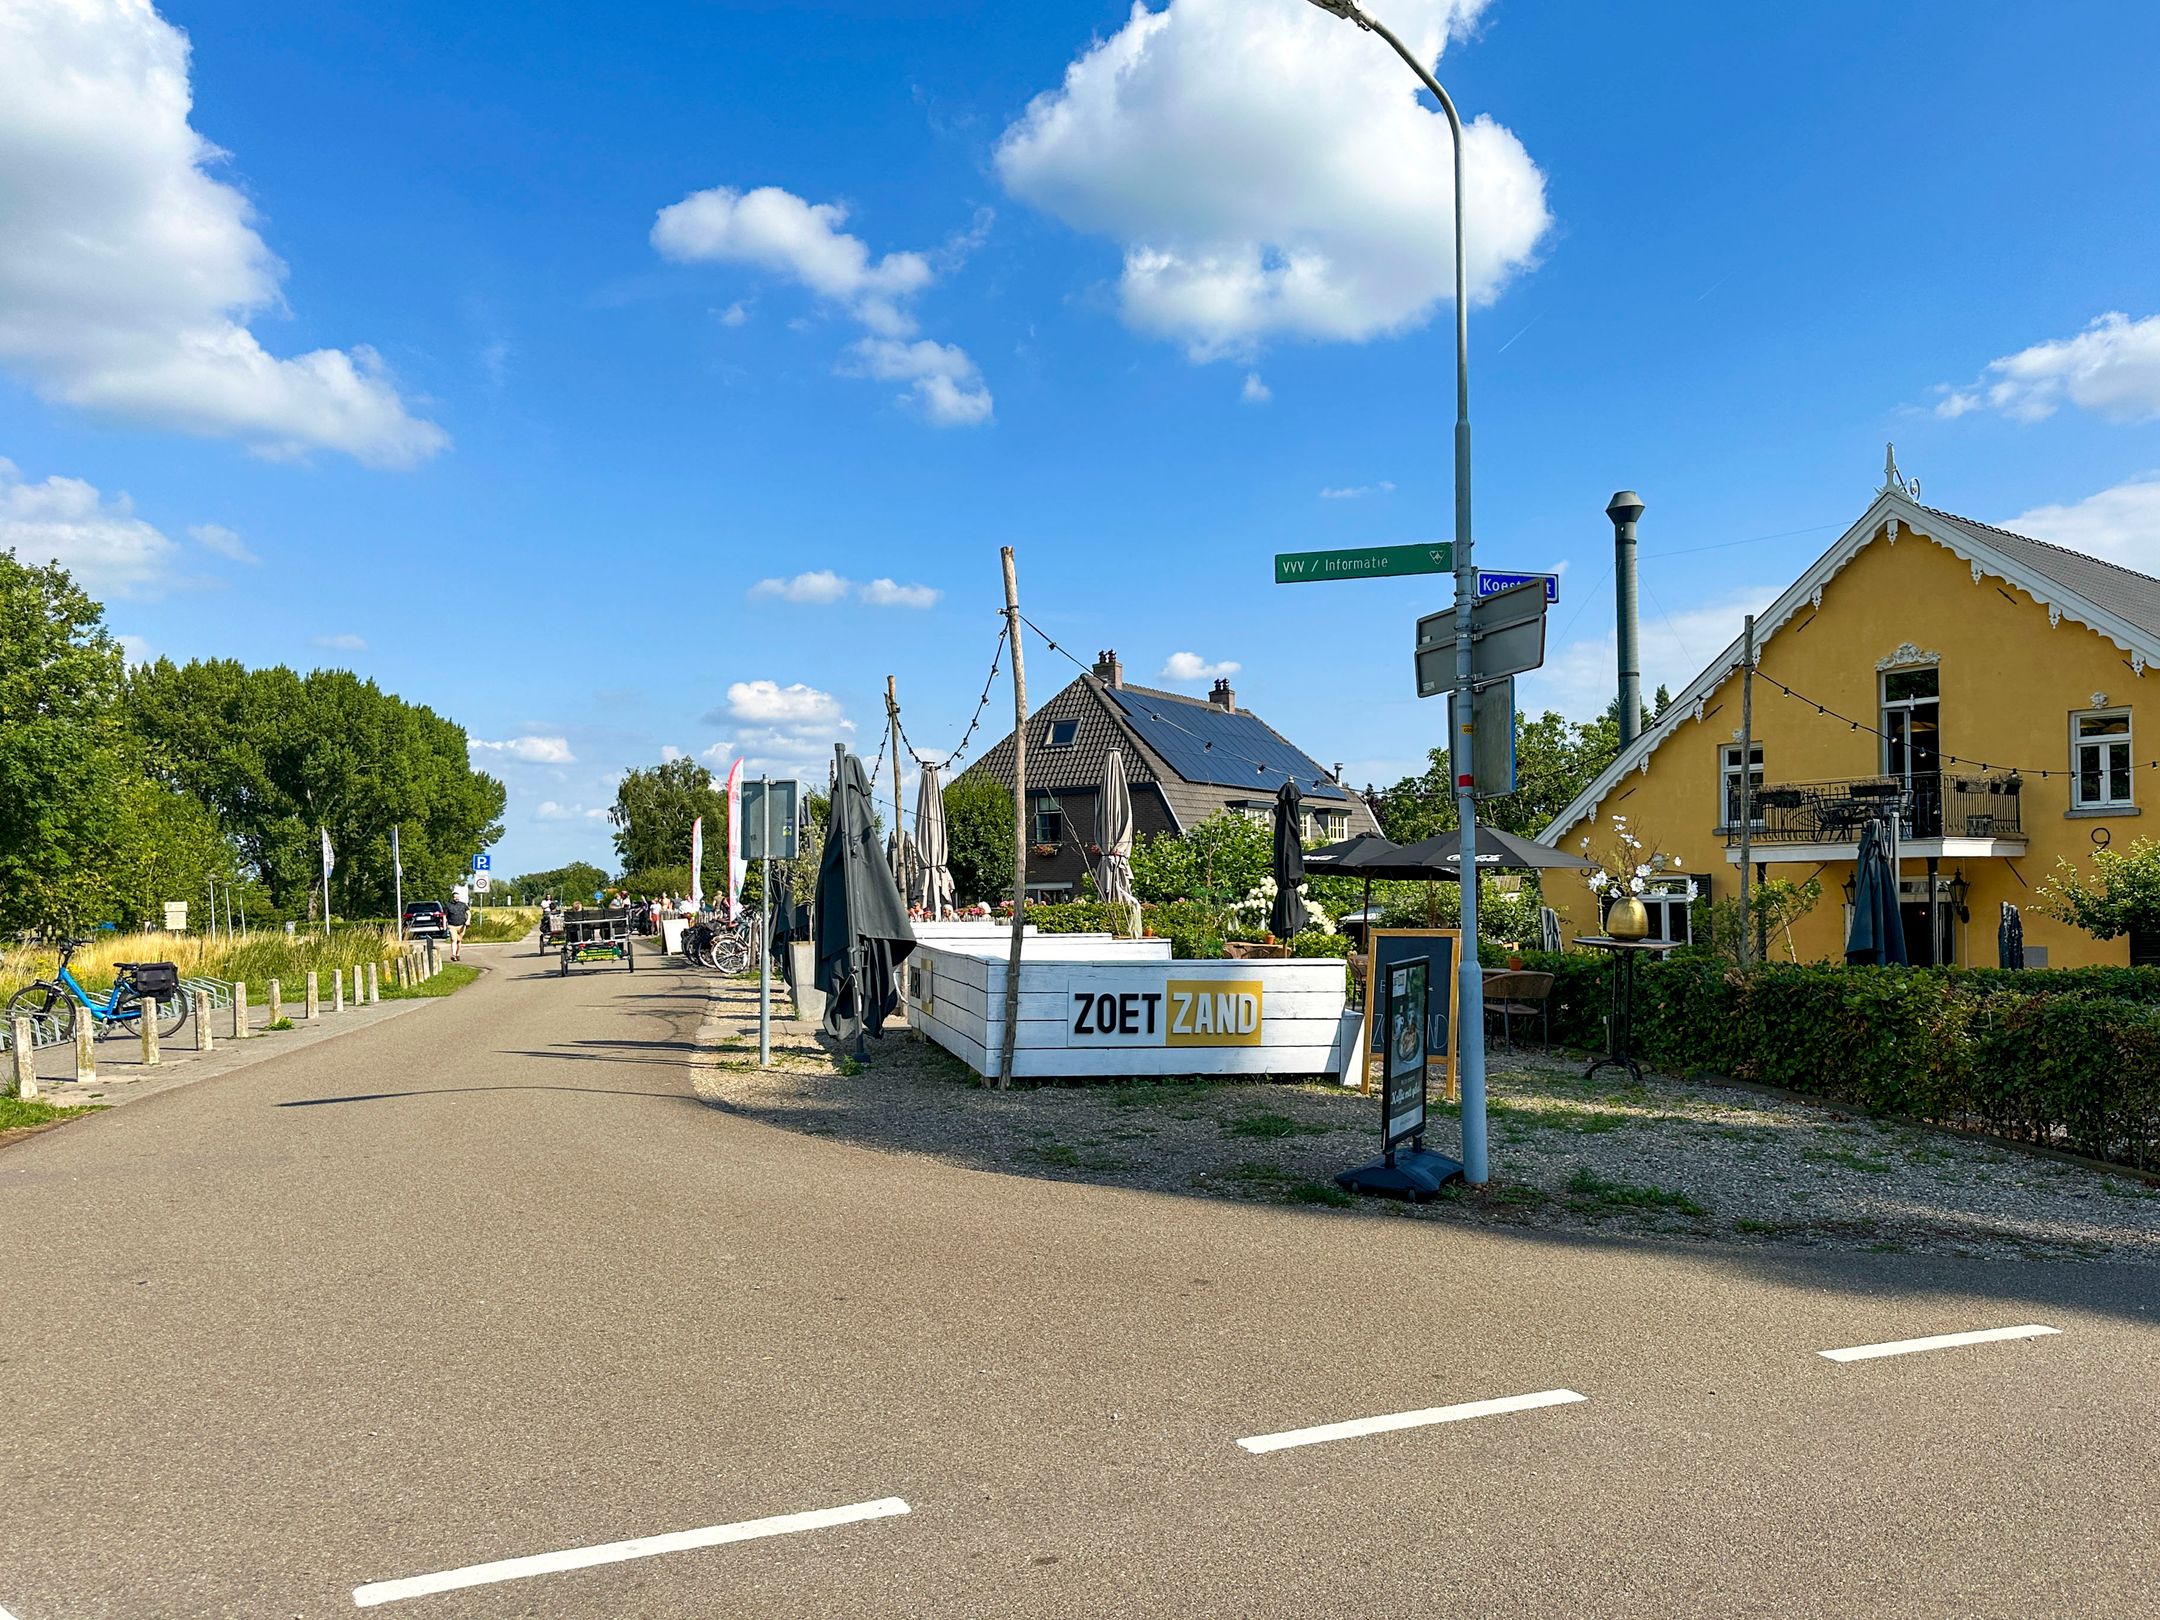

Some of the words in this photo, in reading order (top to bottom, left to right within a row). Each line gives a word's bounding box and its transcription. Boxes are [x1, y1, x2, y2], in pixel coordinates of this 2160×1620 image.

[1283, 560, 1304, 574] VVV
[1311, 559, 1319, 572] /
[1325, 556, 1389, 571] Informatie
[2087, 827, 2111, 857] 9
[477, 857, 487, 869] P
[1074, 993, 1162, 1034] ZOET
[1172, 992, 1258, 1035] ZAND
